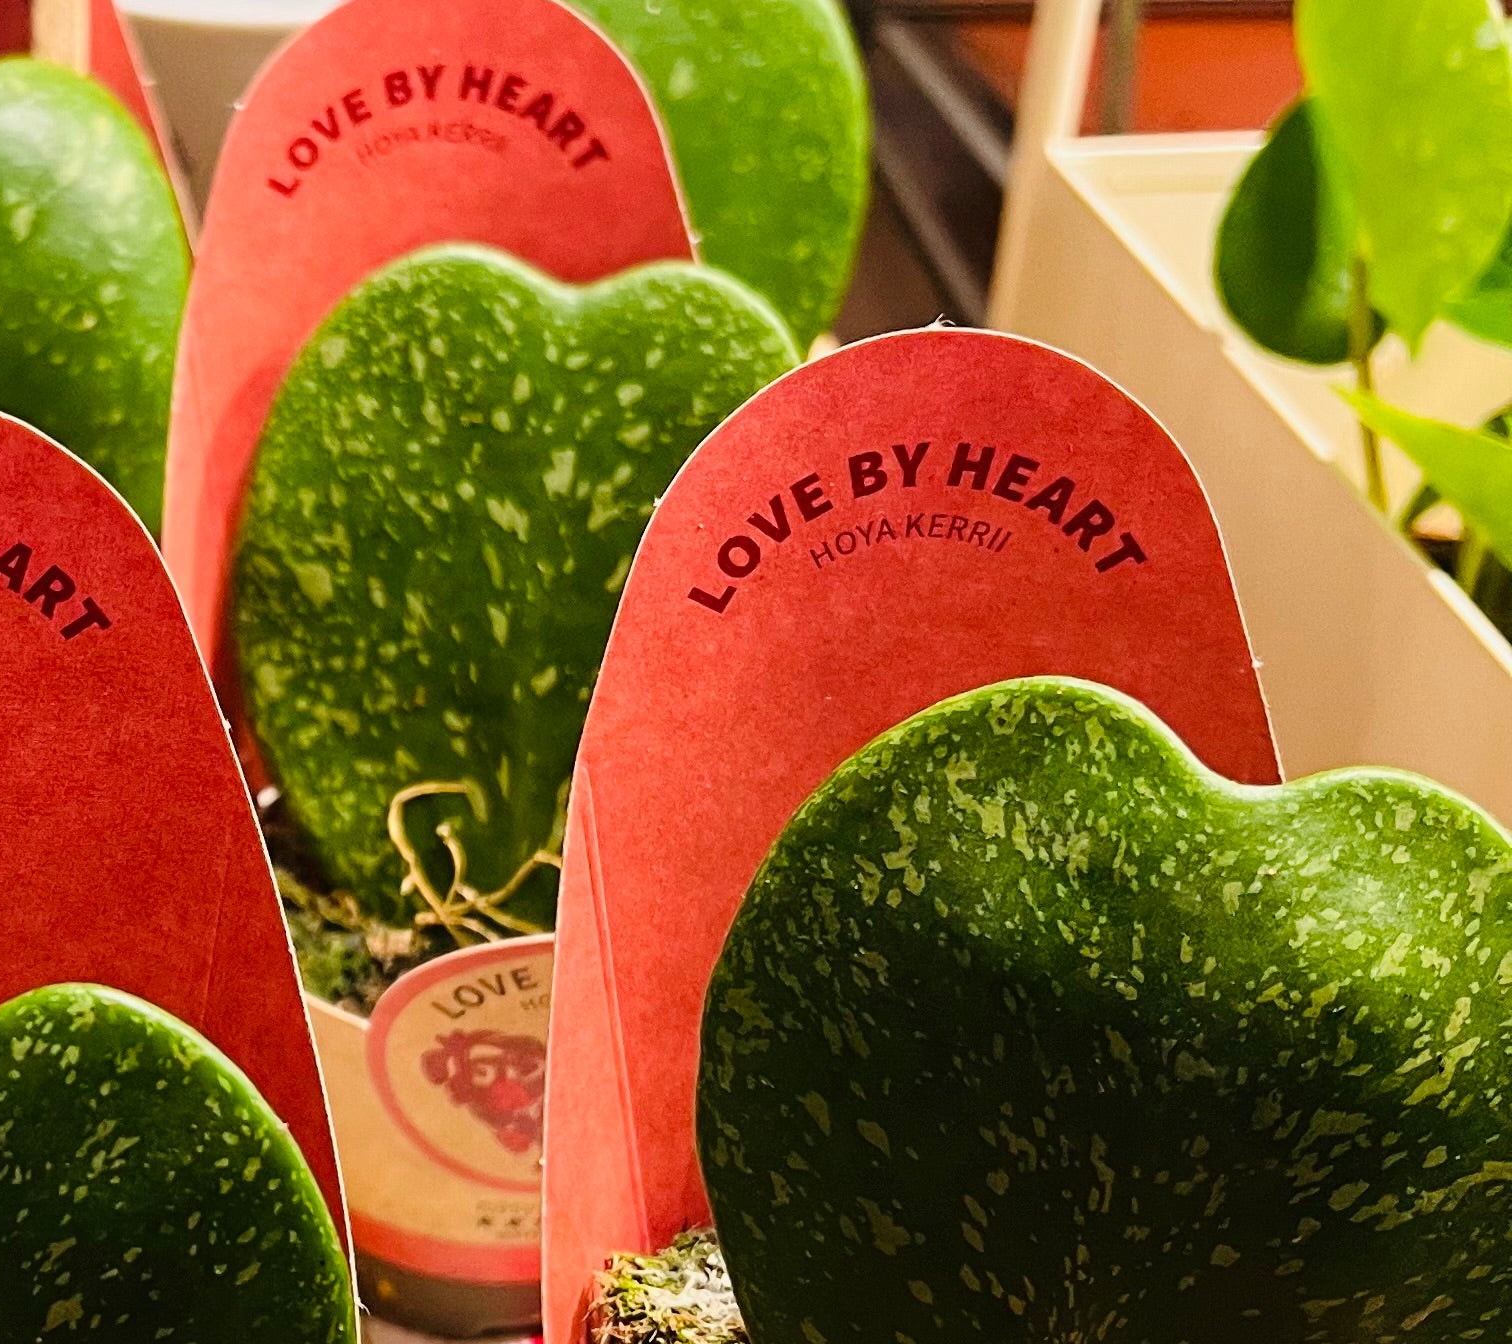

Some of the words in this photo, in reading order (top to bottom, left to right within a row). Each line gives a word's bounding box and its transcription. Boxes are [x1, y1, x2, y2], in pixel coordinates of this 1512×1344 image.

[267, 88, 372, 199] LOVE
[384, 64, 446, 108] BY
[458, 60, 610, 170] HEART
[687, 473, 833, 615] LOVE
[847, 442, 931, 499] BY
[946, 442, 1148, 574] HEART
[809, 517, 897, 570] HOYA
[905, 513, 1012, 553] KERRII
[432, 967, 538, 1019] LOVE
